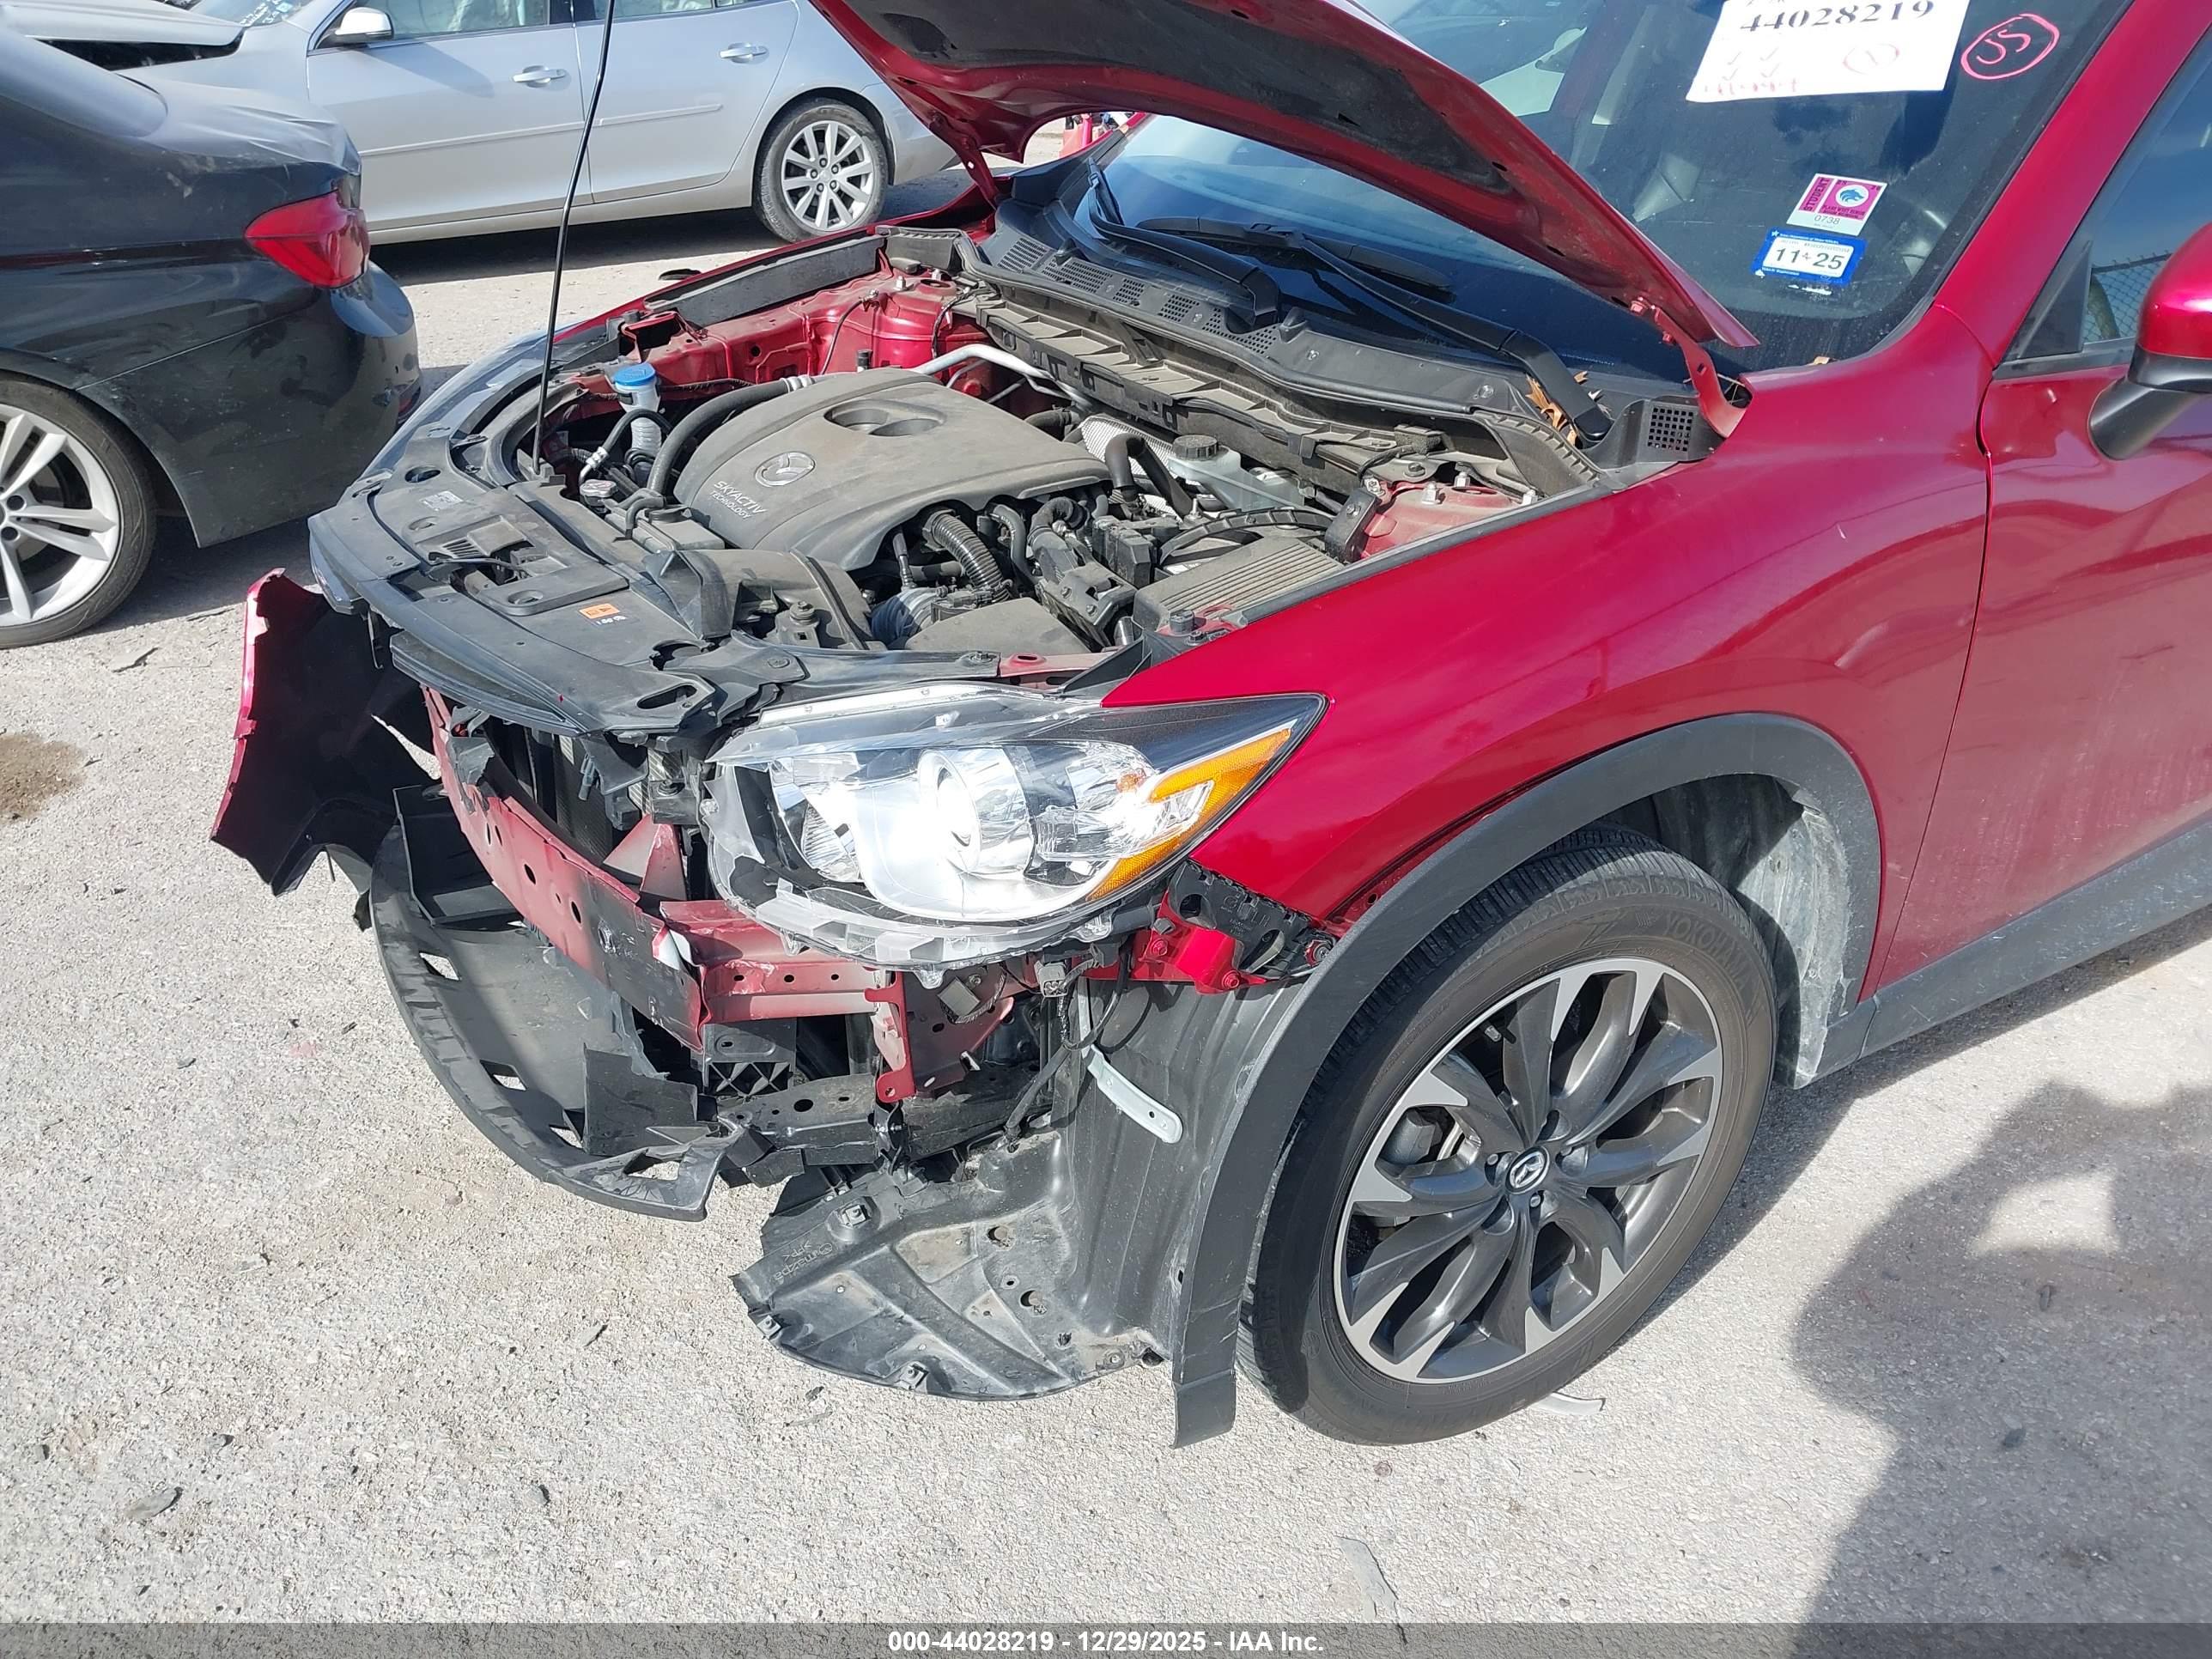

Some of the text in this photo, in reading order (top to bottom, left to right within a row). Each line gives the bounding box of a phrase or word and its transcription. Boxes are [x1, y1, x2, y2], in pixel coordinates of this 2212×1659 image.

[1740, 0, 1935, 32] 44028219
[1803, 177, 1831, 211] STUDENT
[1814, 215, 1840, 225] 0738
[1813, 252, 1844, 269] 25
[710, 490, 751, 519] TECHNOLOGY
[714, 481, 769, 514] SKYACTIV
